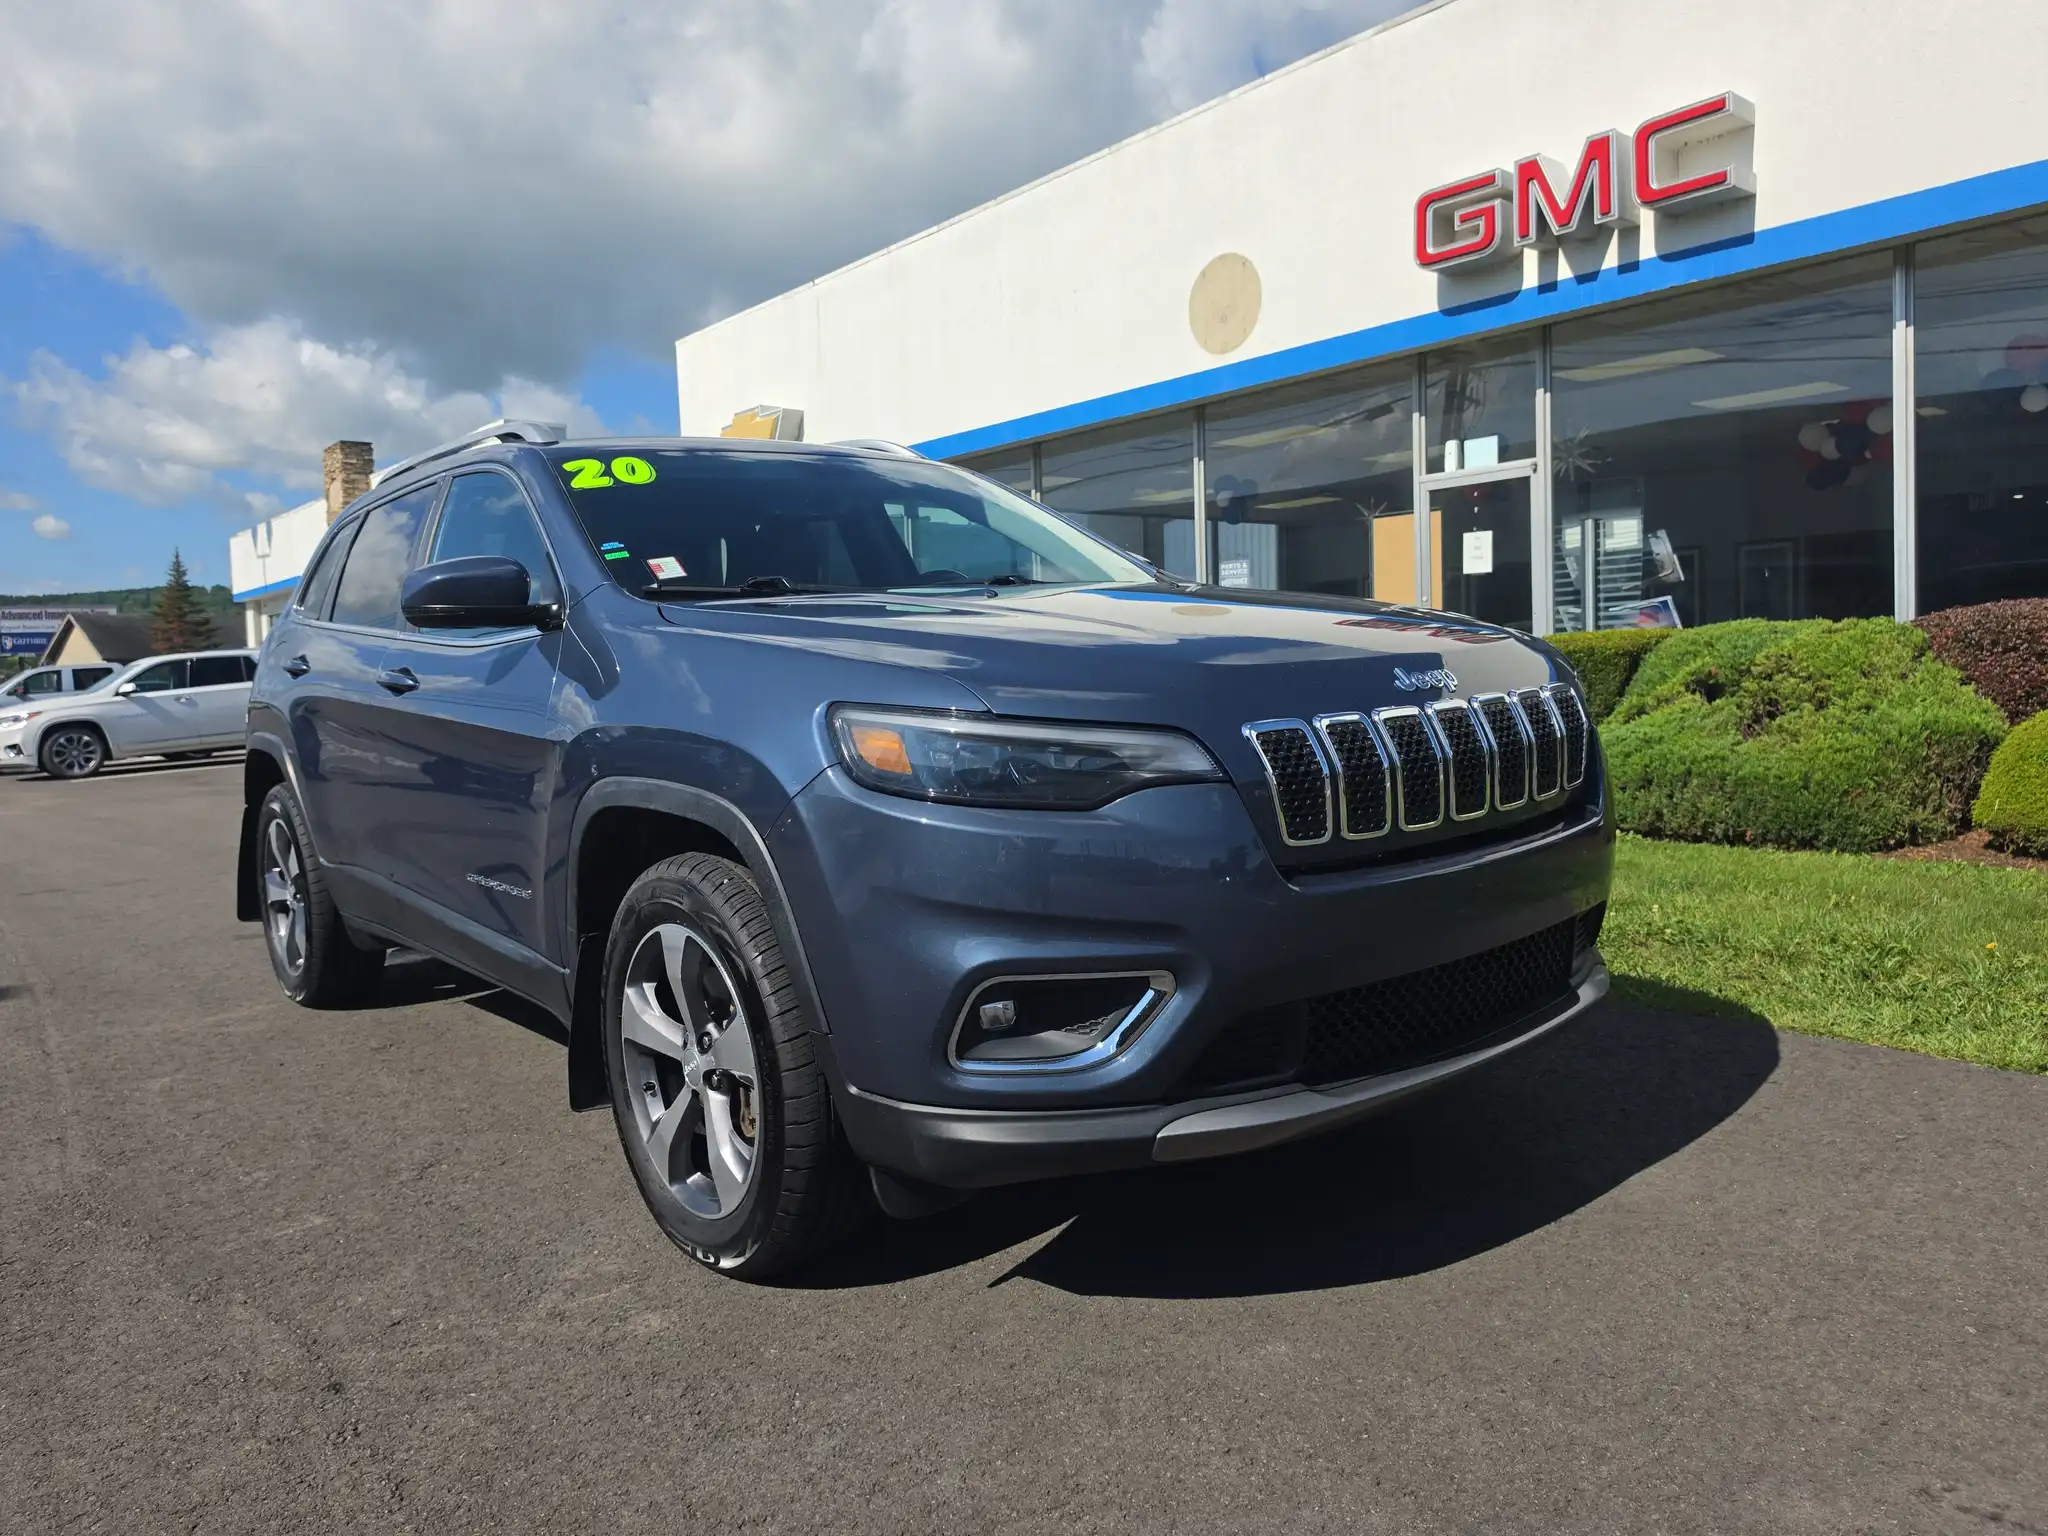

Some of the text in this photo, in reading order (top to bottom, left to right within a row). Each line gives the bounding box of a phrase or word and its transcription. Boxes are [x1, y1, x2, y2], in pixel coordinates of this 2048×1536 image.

[1414, 90, 1743, 272] GMC
[562, 456, 657, 490] 20
[1, 609, 44, 621] Advanced
[1393, 667, 1458, 693] Jeep
